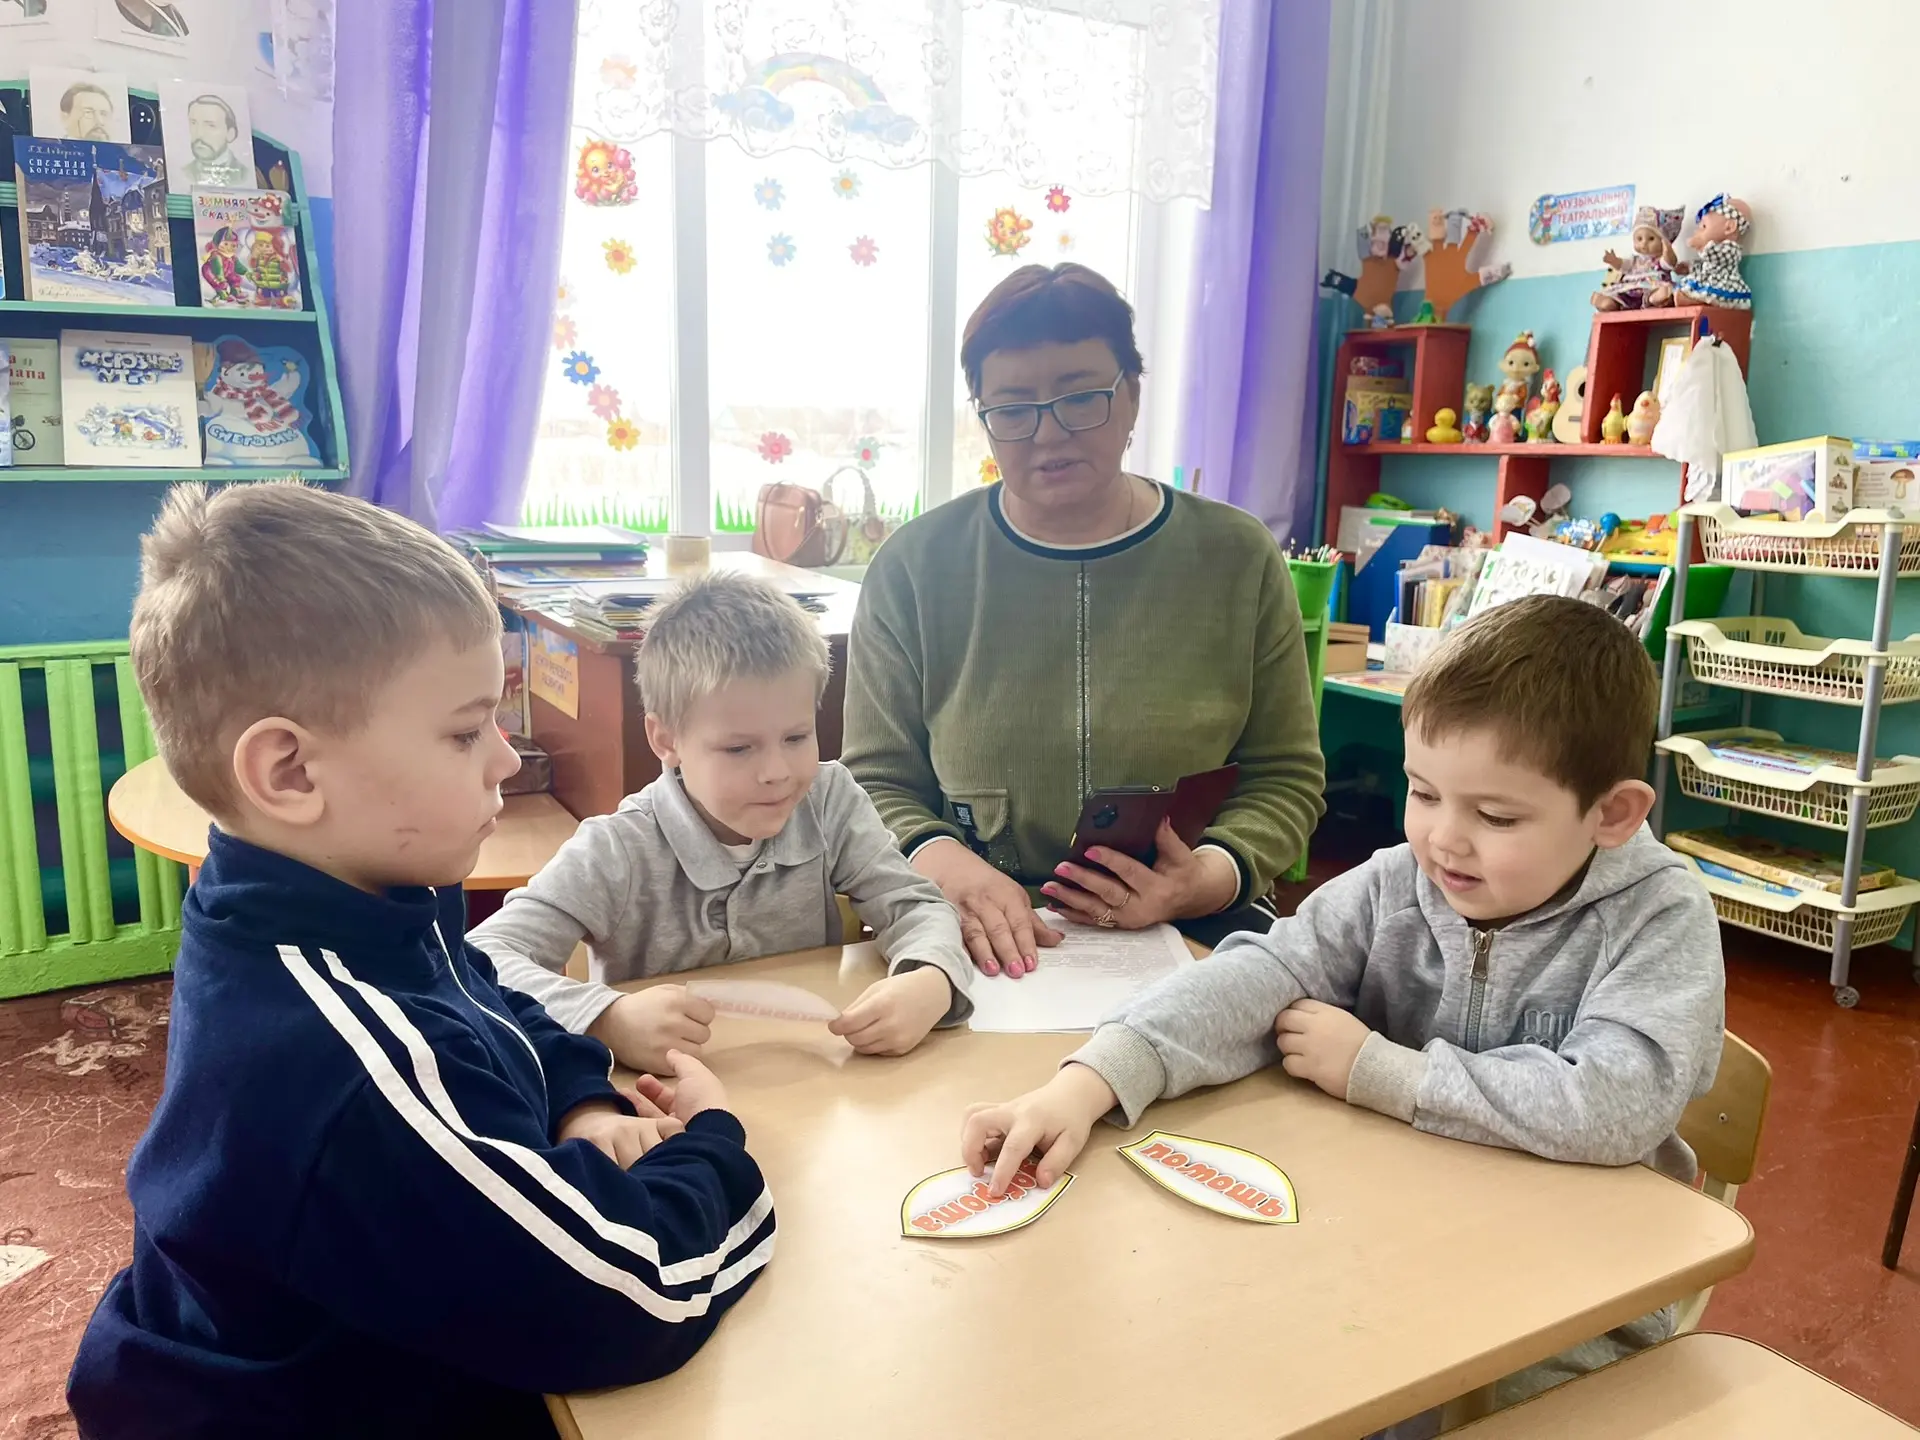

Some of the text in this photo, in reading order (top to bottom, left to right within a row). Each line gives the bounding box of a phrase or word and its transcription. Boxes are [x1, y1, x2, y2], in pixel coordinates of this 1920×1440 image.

[28, 158, 86, 169] СНЕЖНАЯ
[29, 167, 86, 177] КОРОЛЕВА
[198, 196, 247, 208] ЗИМНЯЯ
[208, 423, 299, 447] СНЕГОВИК
